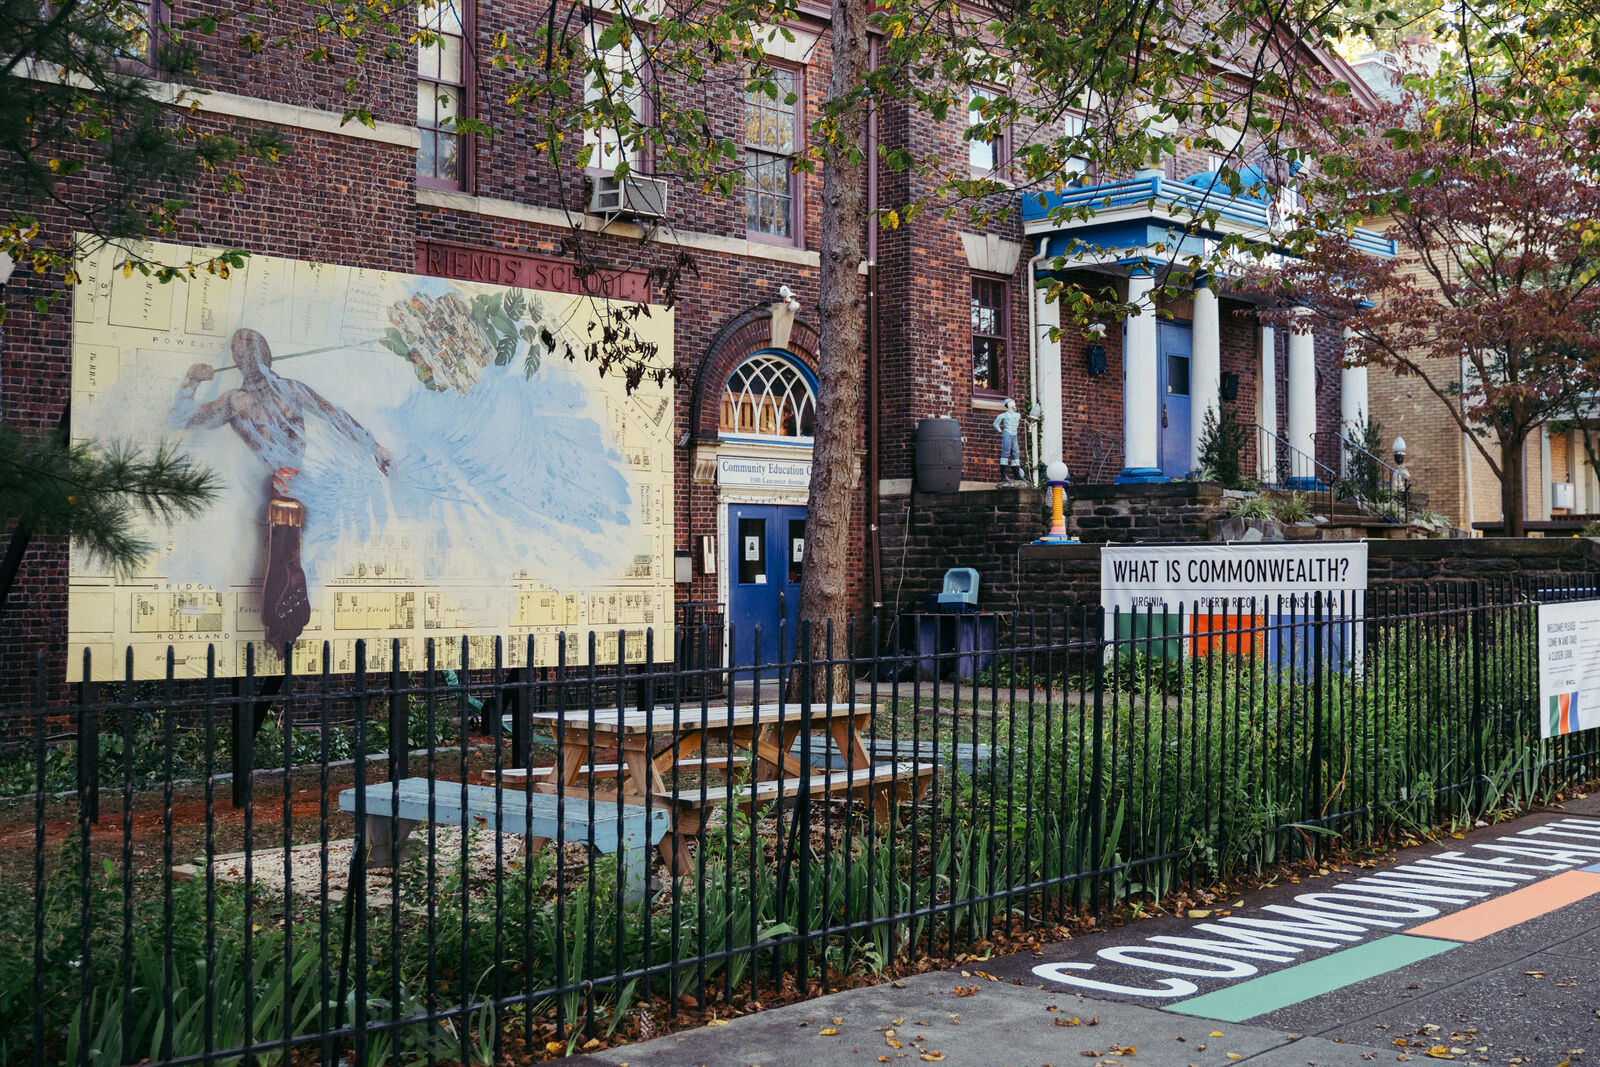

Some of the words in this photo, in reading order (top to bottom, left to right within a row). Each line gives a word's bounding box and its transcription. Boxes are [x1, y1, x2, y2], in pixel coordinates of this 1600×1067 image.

[722, 460, 766, 476] Community
[768, 463, 804, 476] Education
[1113, 560, 1159, 583] WHAT
[1166, 559, 1181, 583] IS
[1188, 557, 1350, 583] COMMONWEALTH?
[1131, 596, 1164, 608] VIRGINIA
[1232, 596, 1252, 608] RCO
